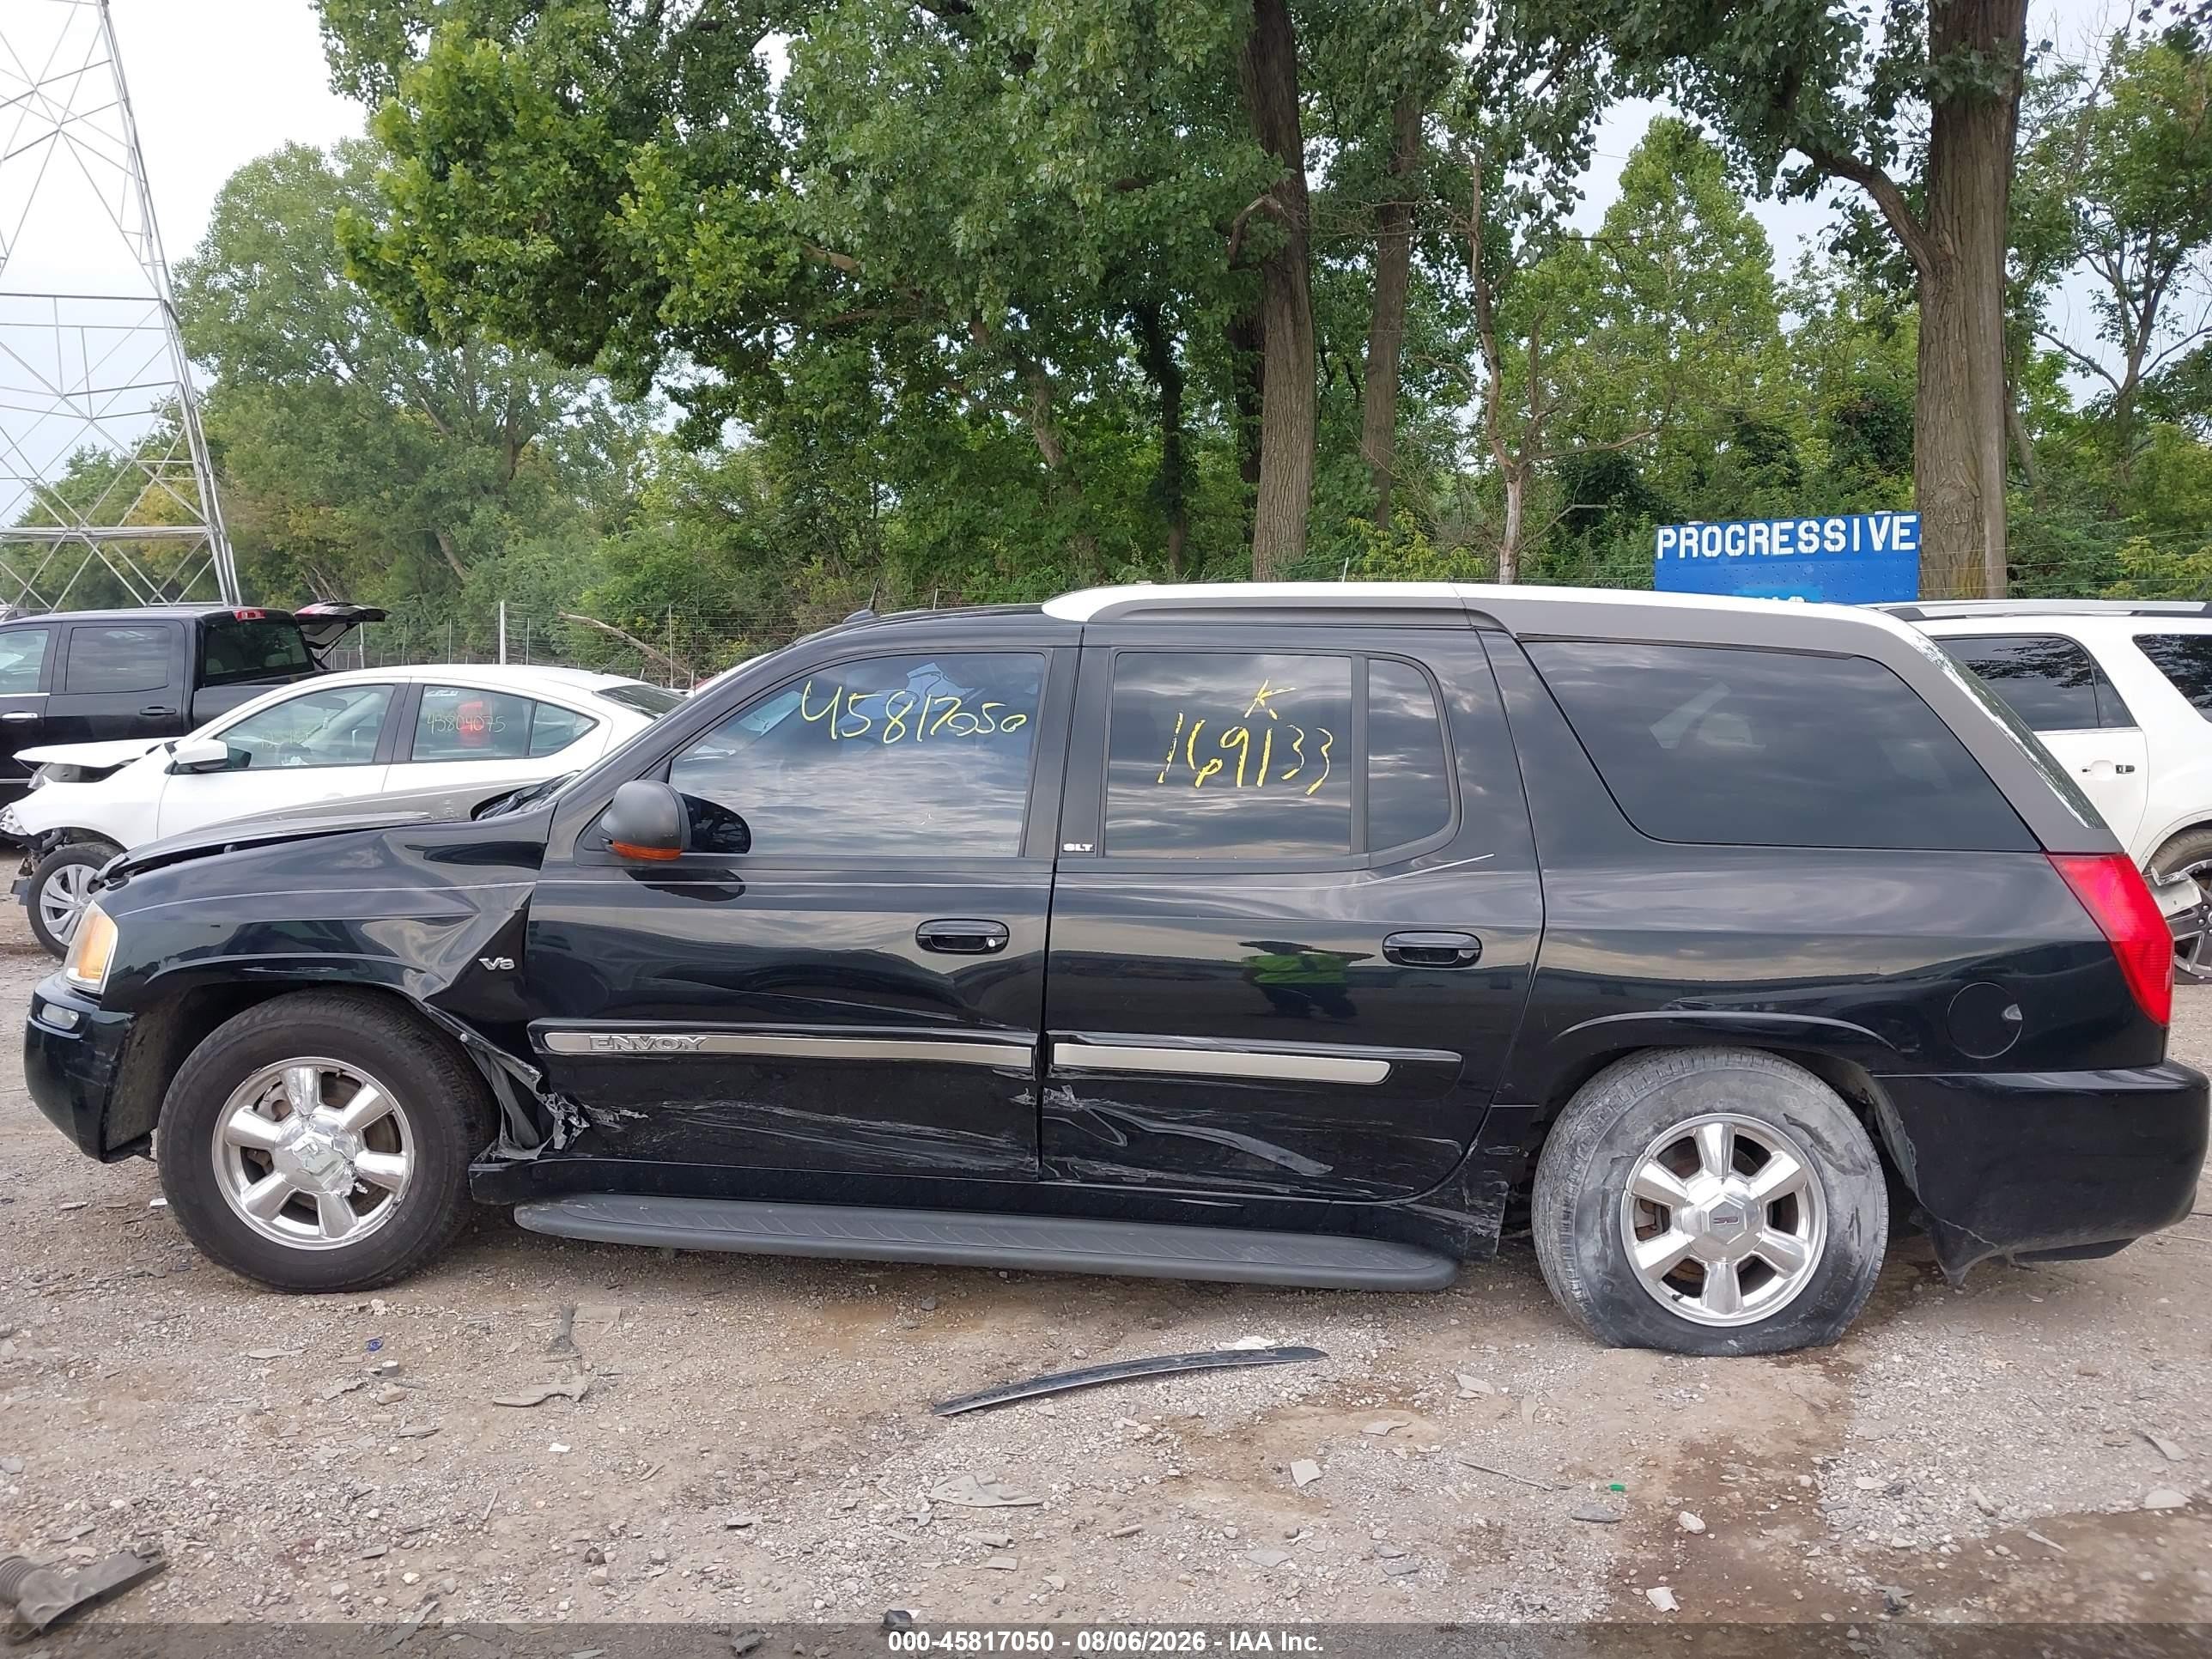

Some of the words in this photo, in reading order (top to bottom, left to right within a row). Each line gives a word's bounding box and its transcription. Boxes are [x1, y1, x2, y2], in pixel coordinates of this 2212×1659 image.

[1657, 514, 1917, 559] PROGRESSIVE
[800, 679, 1028, 744] 45817050
[1157, 710, 1334, 796] 169133
[1063, 842, 1094, 852] SLT
[478, 957, 515, 971] V8
[588, 1035, 708, 1052] ENVOY
